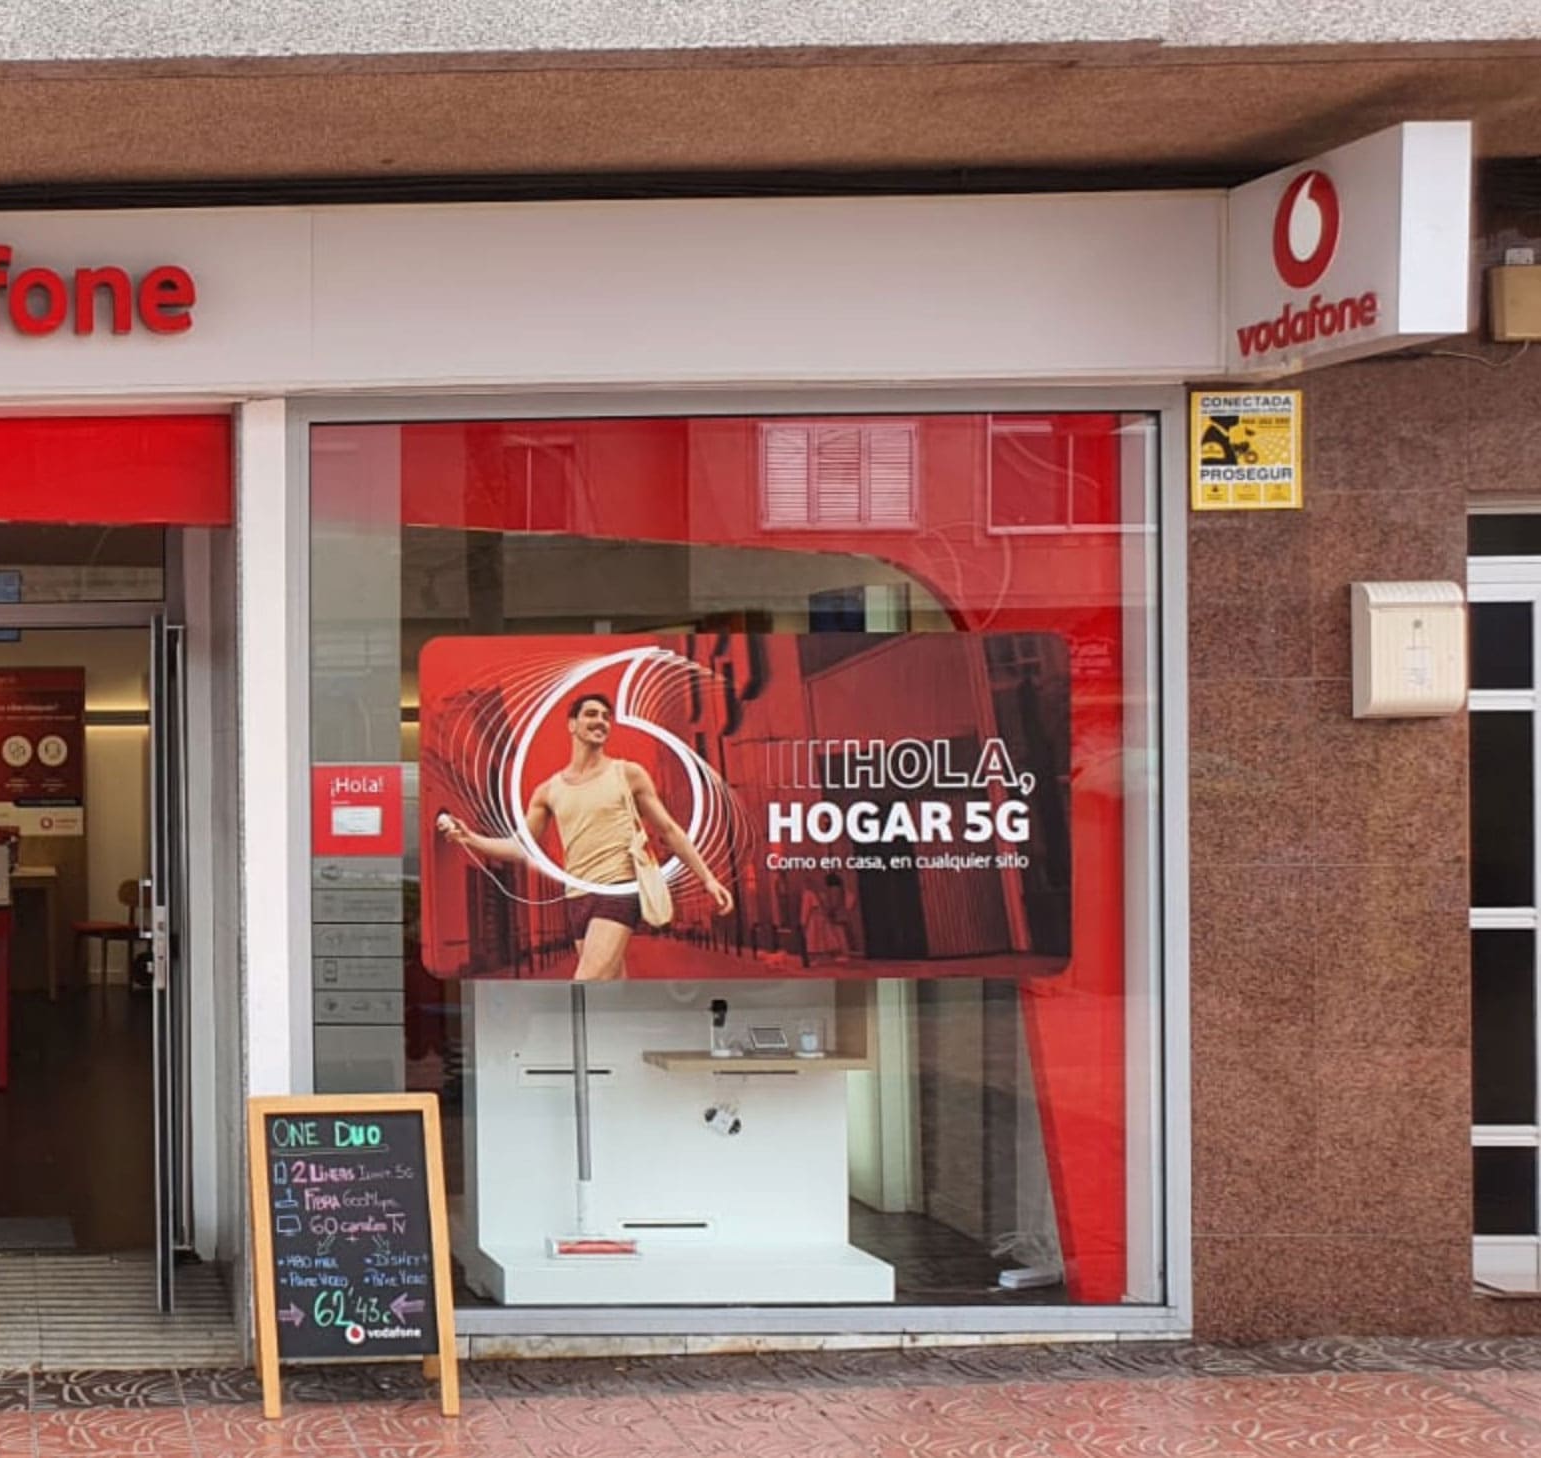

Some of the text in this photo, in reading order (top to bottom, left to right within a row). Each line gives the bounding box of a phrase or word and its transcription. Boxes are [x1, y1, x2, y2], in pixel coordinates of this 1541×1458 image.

[1237, 291, 1378, 357] vodafone
[1200, 395, 1292, 408] CONECTADA
[1200, 467, 1293, 481] PROSEGUR
[843, 738, 1035, 795] HOLA,
[330, 776, 385, 796] ¡Hola!
[767, 800, 1030, 844] HOGAR 5G
[766, 852, 1029, 873] Como en casa, en cualquier sitio
[272, 1118, 321, 1147] ONE
[290, 1160, 308, 1183] 2
[309, 1215, 338, 1235] 60
[367, 1326, 422, 1339] vodafone
